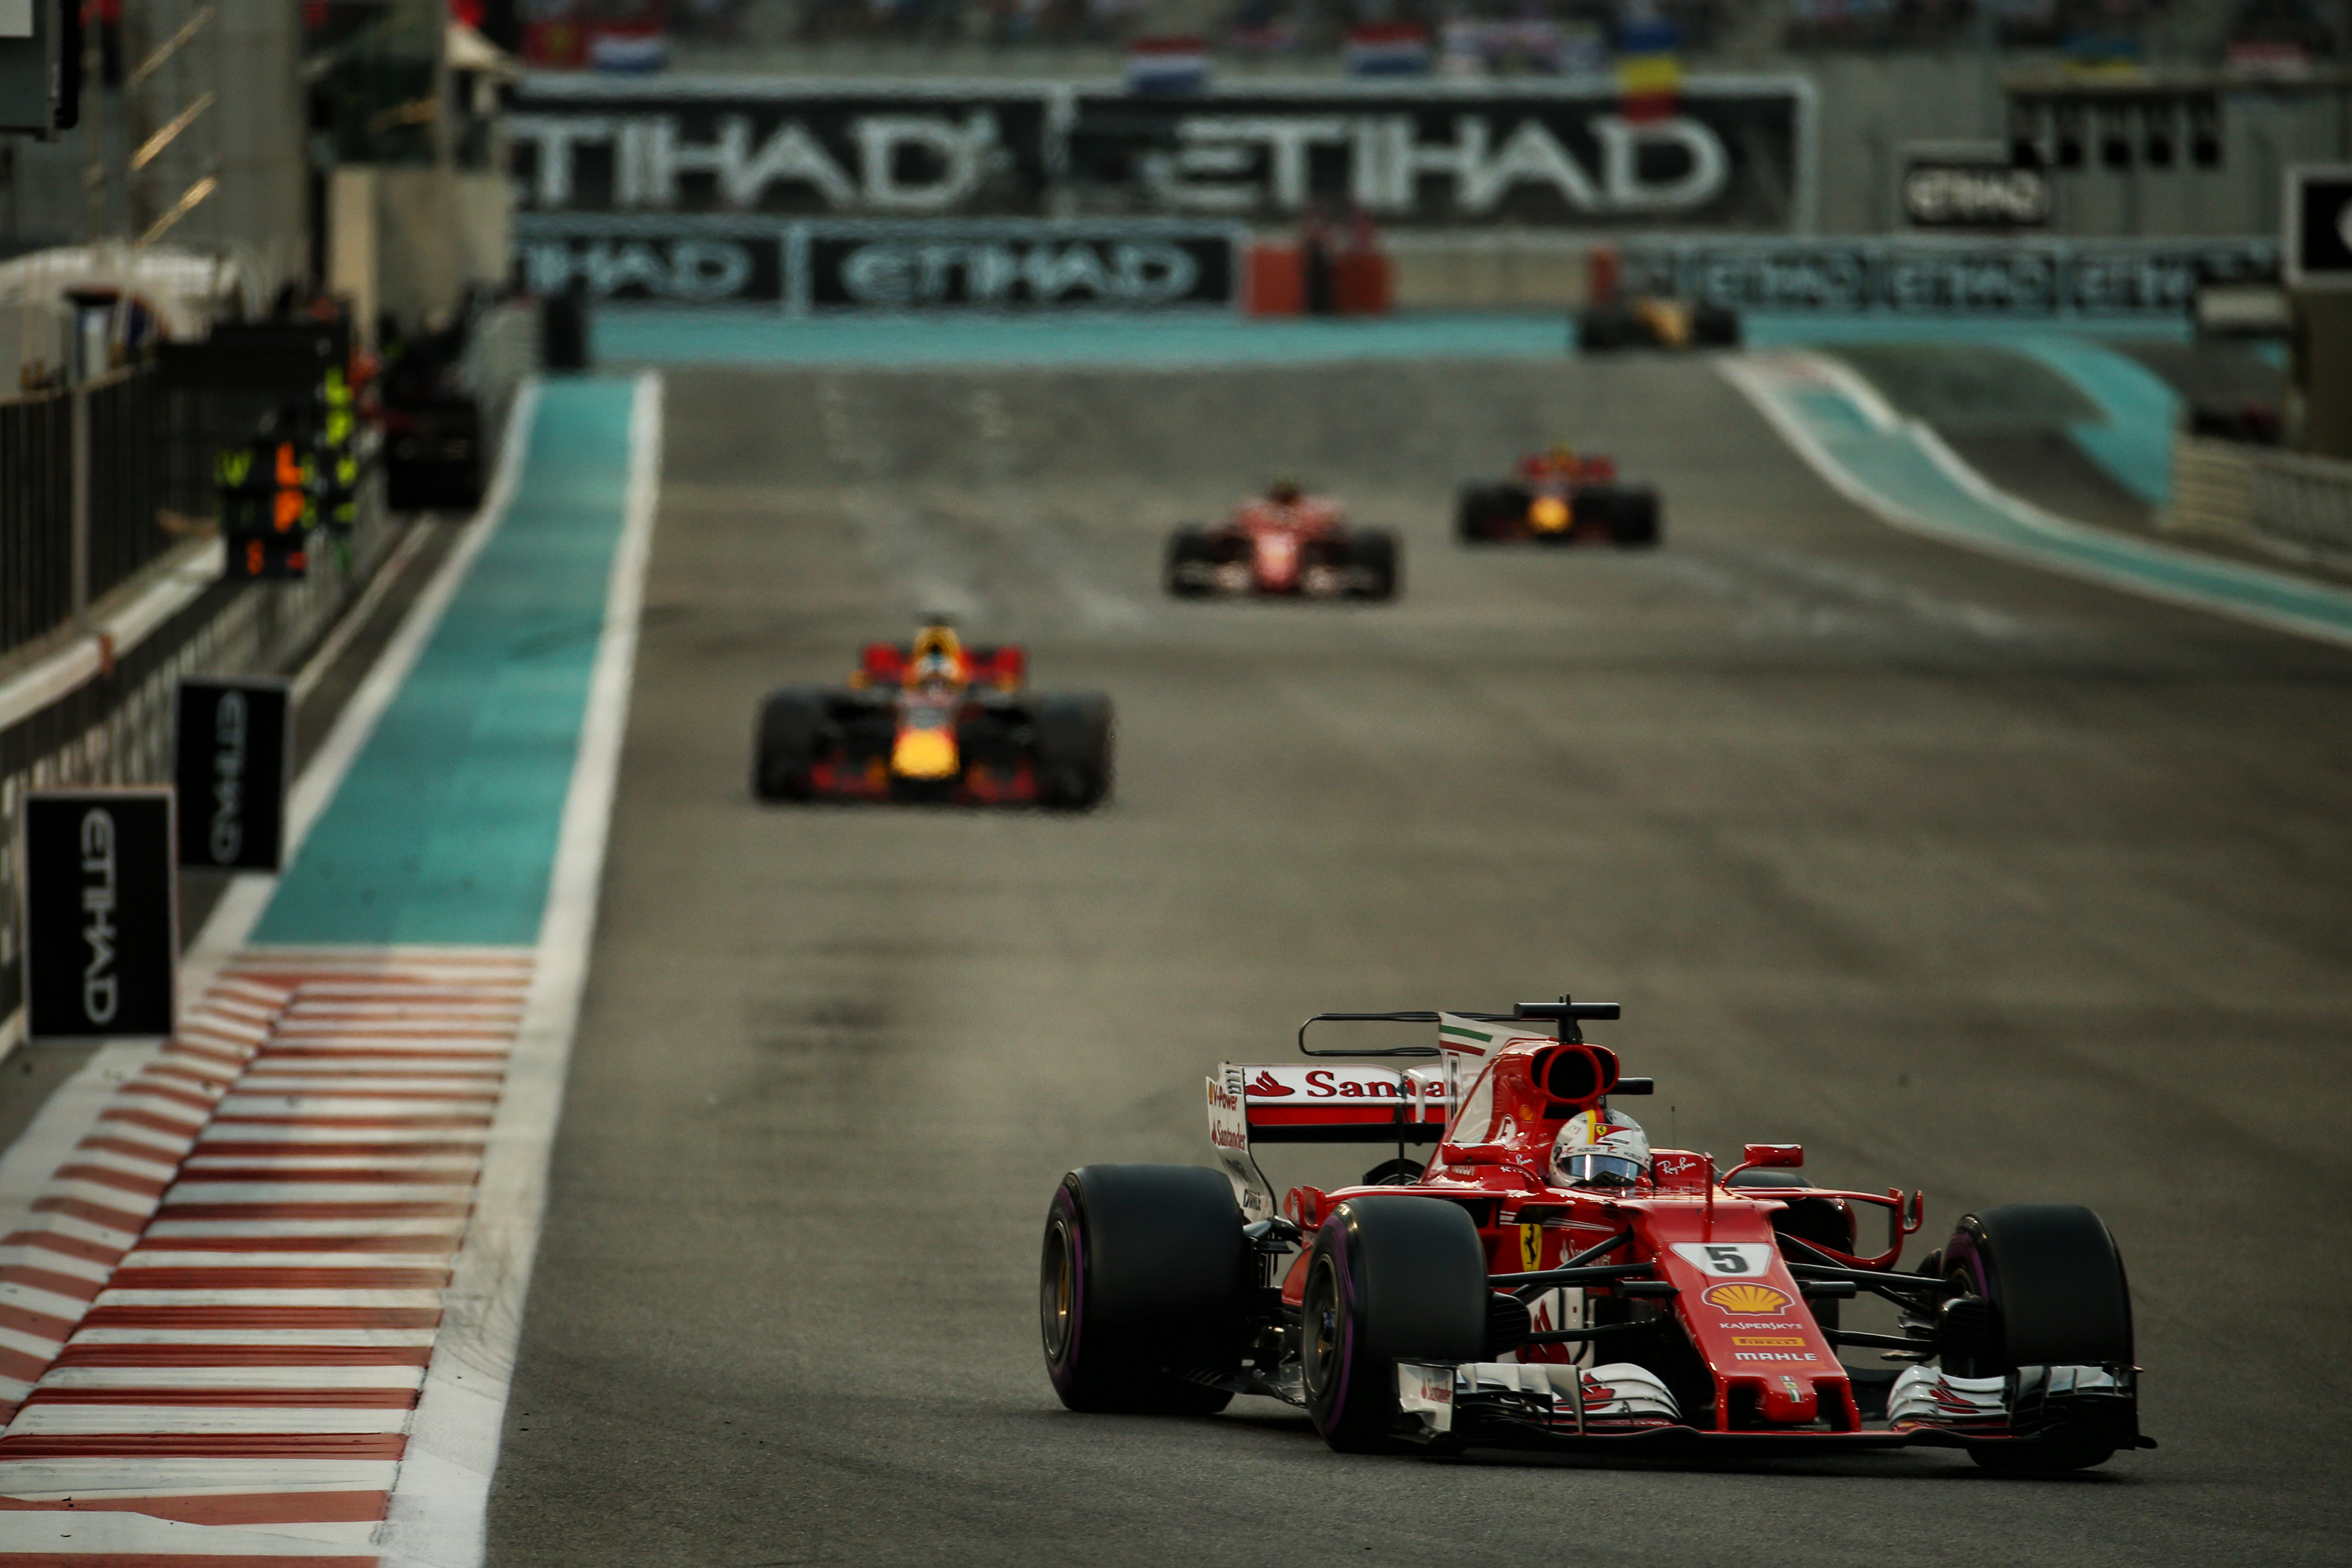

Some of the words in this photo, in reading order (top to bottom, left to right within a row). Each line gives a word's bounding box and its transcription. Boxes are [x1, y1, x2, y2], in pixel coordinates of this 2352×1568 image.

[507, 112, 979, 208] TIHAD
[1141, 113, 1730, 211] ETIHAD
[525, 242, 754, 298] IHAD
[842, 243, 1199, 301] ETIHAD
[209, 688, 248, 865] ETIHAD
[80, 807, 118, 1025] ETIHAD
[1213, 1083, 1238, 1112] V-Power
[1305, 1070, 1446, 1098] Santa
[1217, 1119, 1246, 1151] Santander
[1656, 1157, 1696, 1175] Ray-Ban
[1703, 1246, 1749, 1274] 5
[1734, 1352, 1818, 1361] MAHLE
